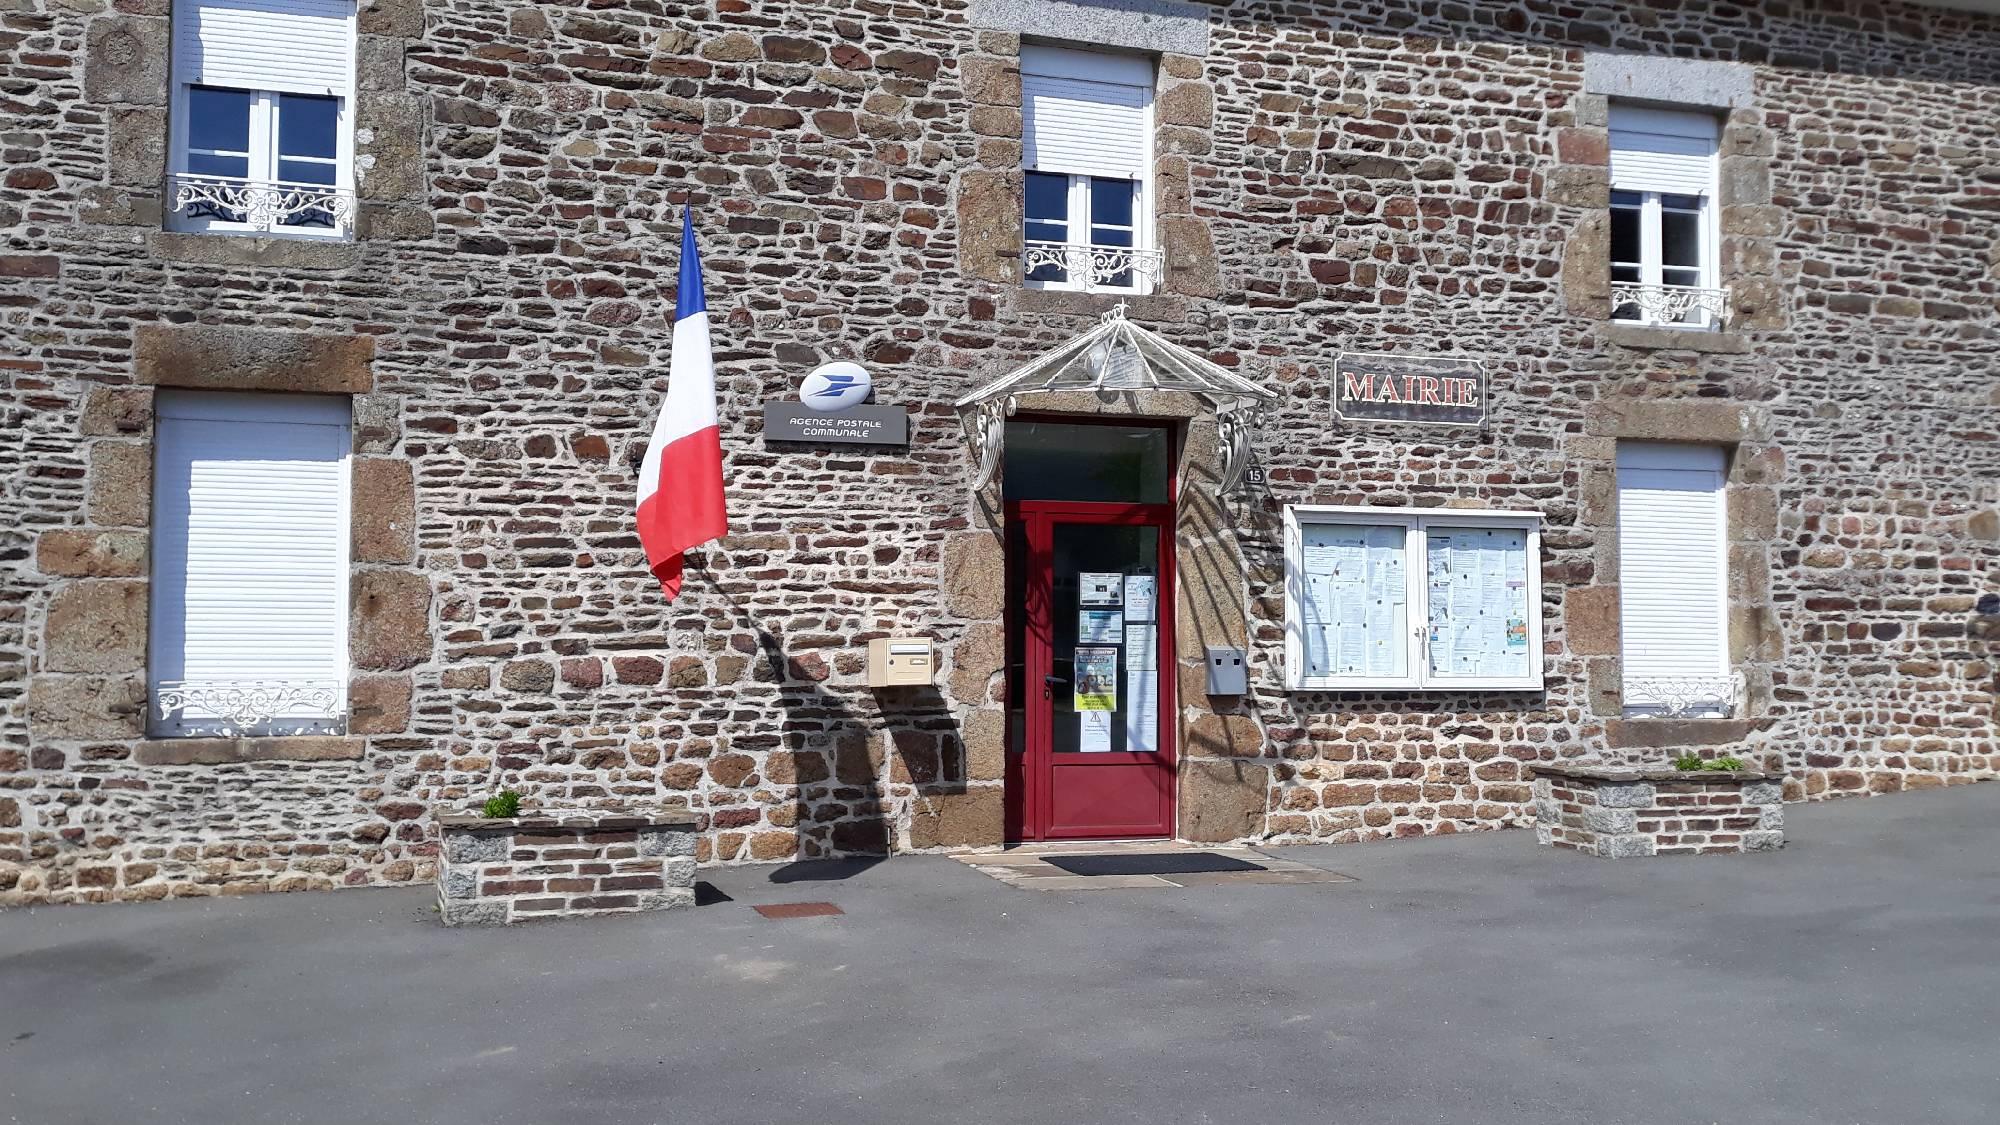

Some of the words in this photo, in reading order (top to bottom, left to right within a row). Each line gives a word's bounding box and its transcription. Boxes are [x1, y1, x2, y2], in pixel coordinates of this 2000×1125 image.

[1341, 371, 1479, 408] MAIRIE
[789, 417, 833, 427] AGENCE
[837, 419, 882, 428] POSTALE
[803, 427, 870, 438] COMMUNALE
[1249, 470, 1261, 481] 15
